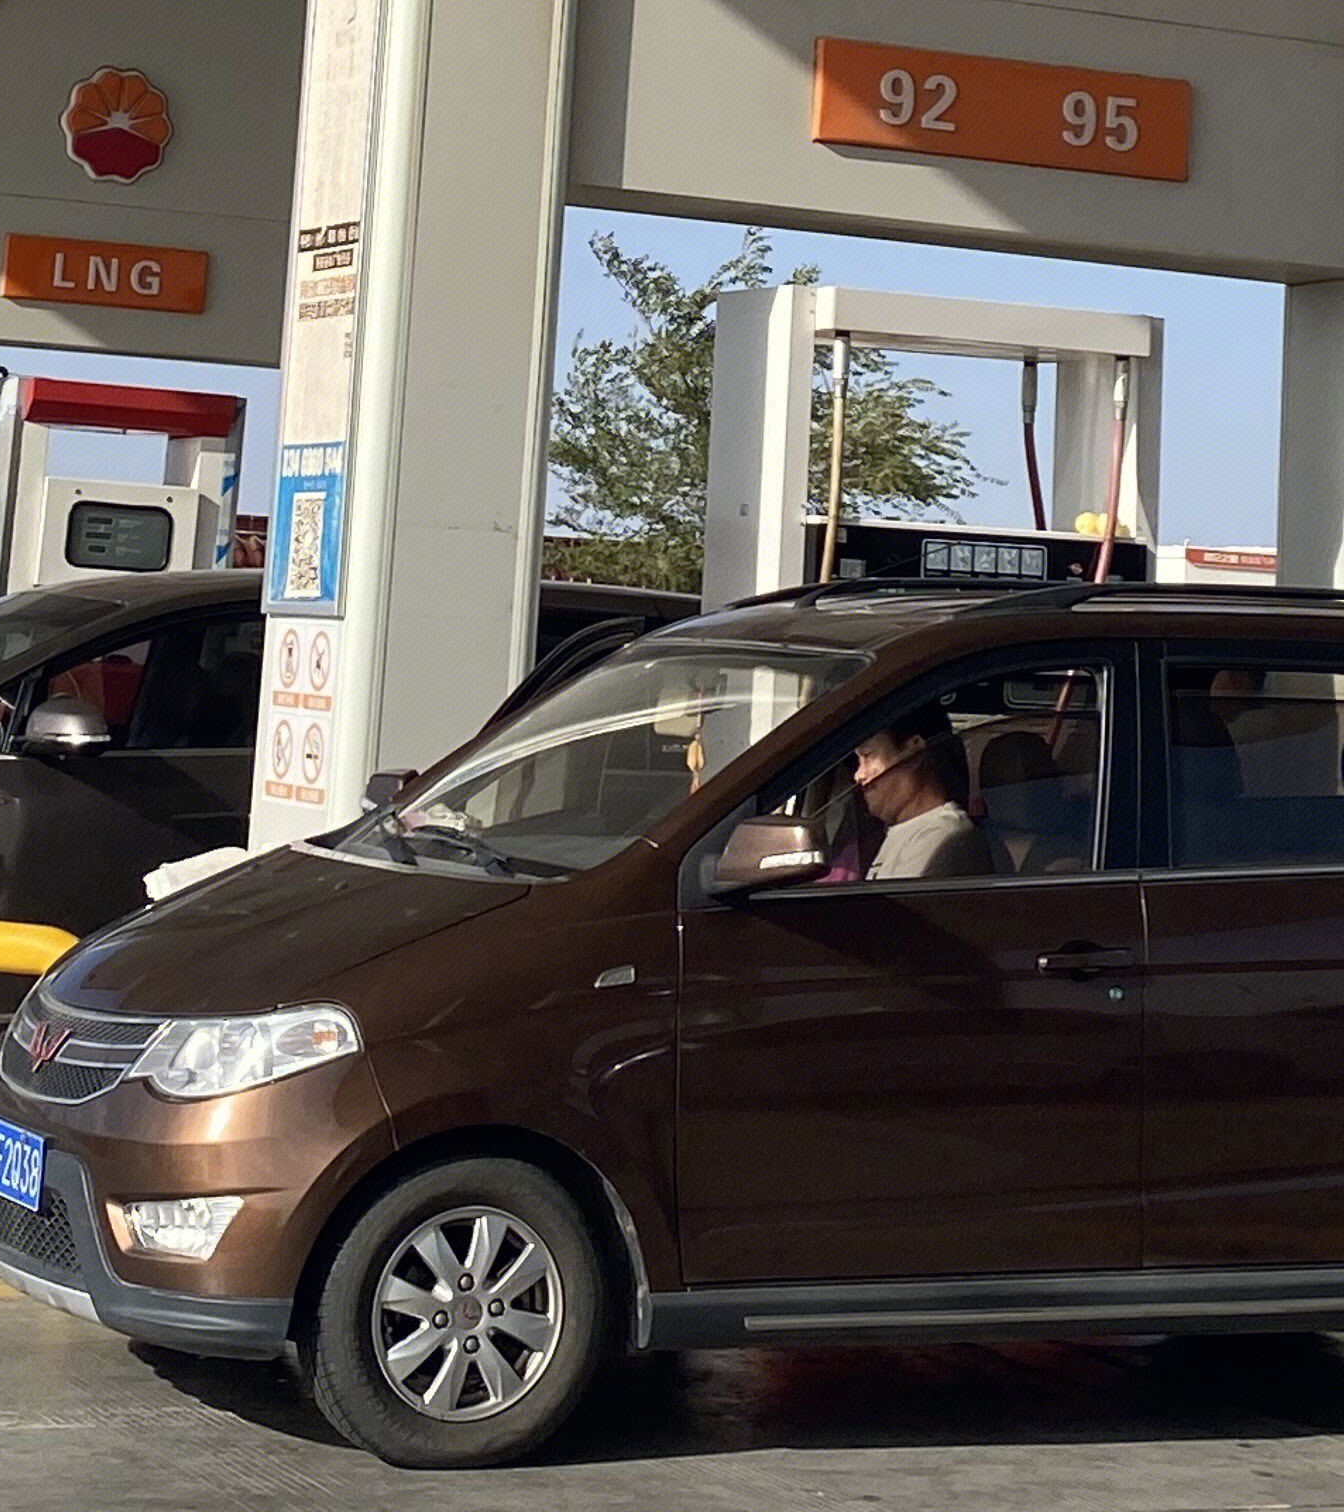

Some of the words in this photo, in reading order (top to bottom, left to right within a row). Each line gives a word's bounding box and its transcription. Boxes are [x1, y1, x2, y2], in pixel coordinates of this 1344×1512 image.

[879, 68, 958, 132] 92
[1062, 90, 1139, 152] 95
[53, 252, 161, 296] LNG
